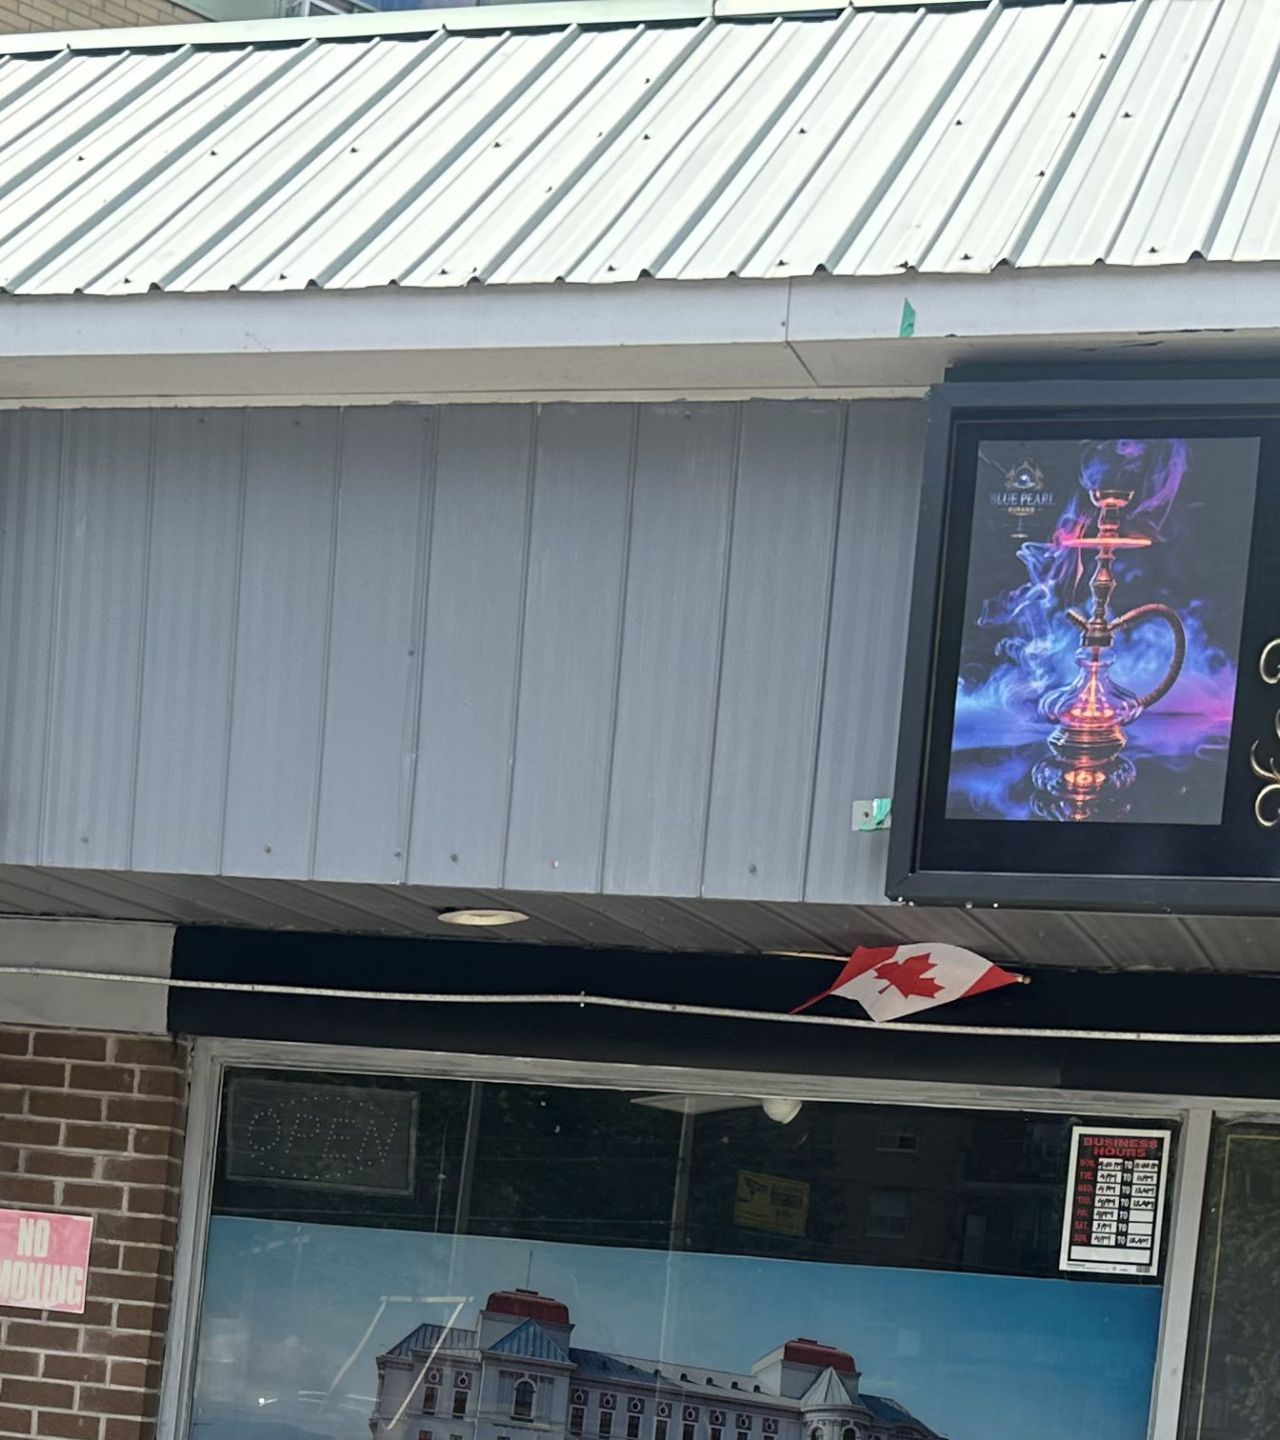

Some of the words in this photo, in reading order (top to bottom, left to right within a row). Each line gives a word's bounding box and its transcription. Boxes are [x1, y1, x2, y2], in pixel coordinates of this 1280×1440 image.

[247, 1110, 399, 1164] OPEN
[1083, 1136, 1159, 1149] BUSINESS
[1093, 1147, 1147, 1158] HOURS
[16, 1217, 51, 1259] NO
